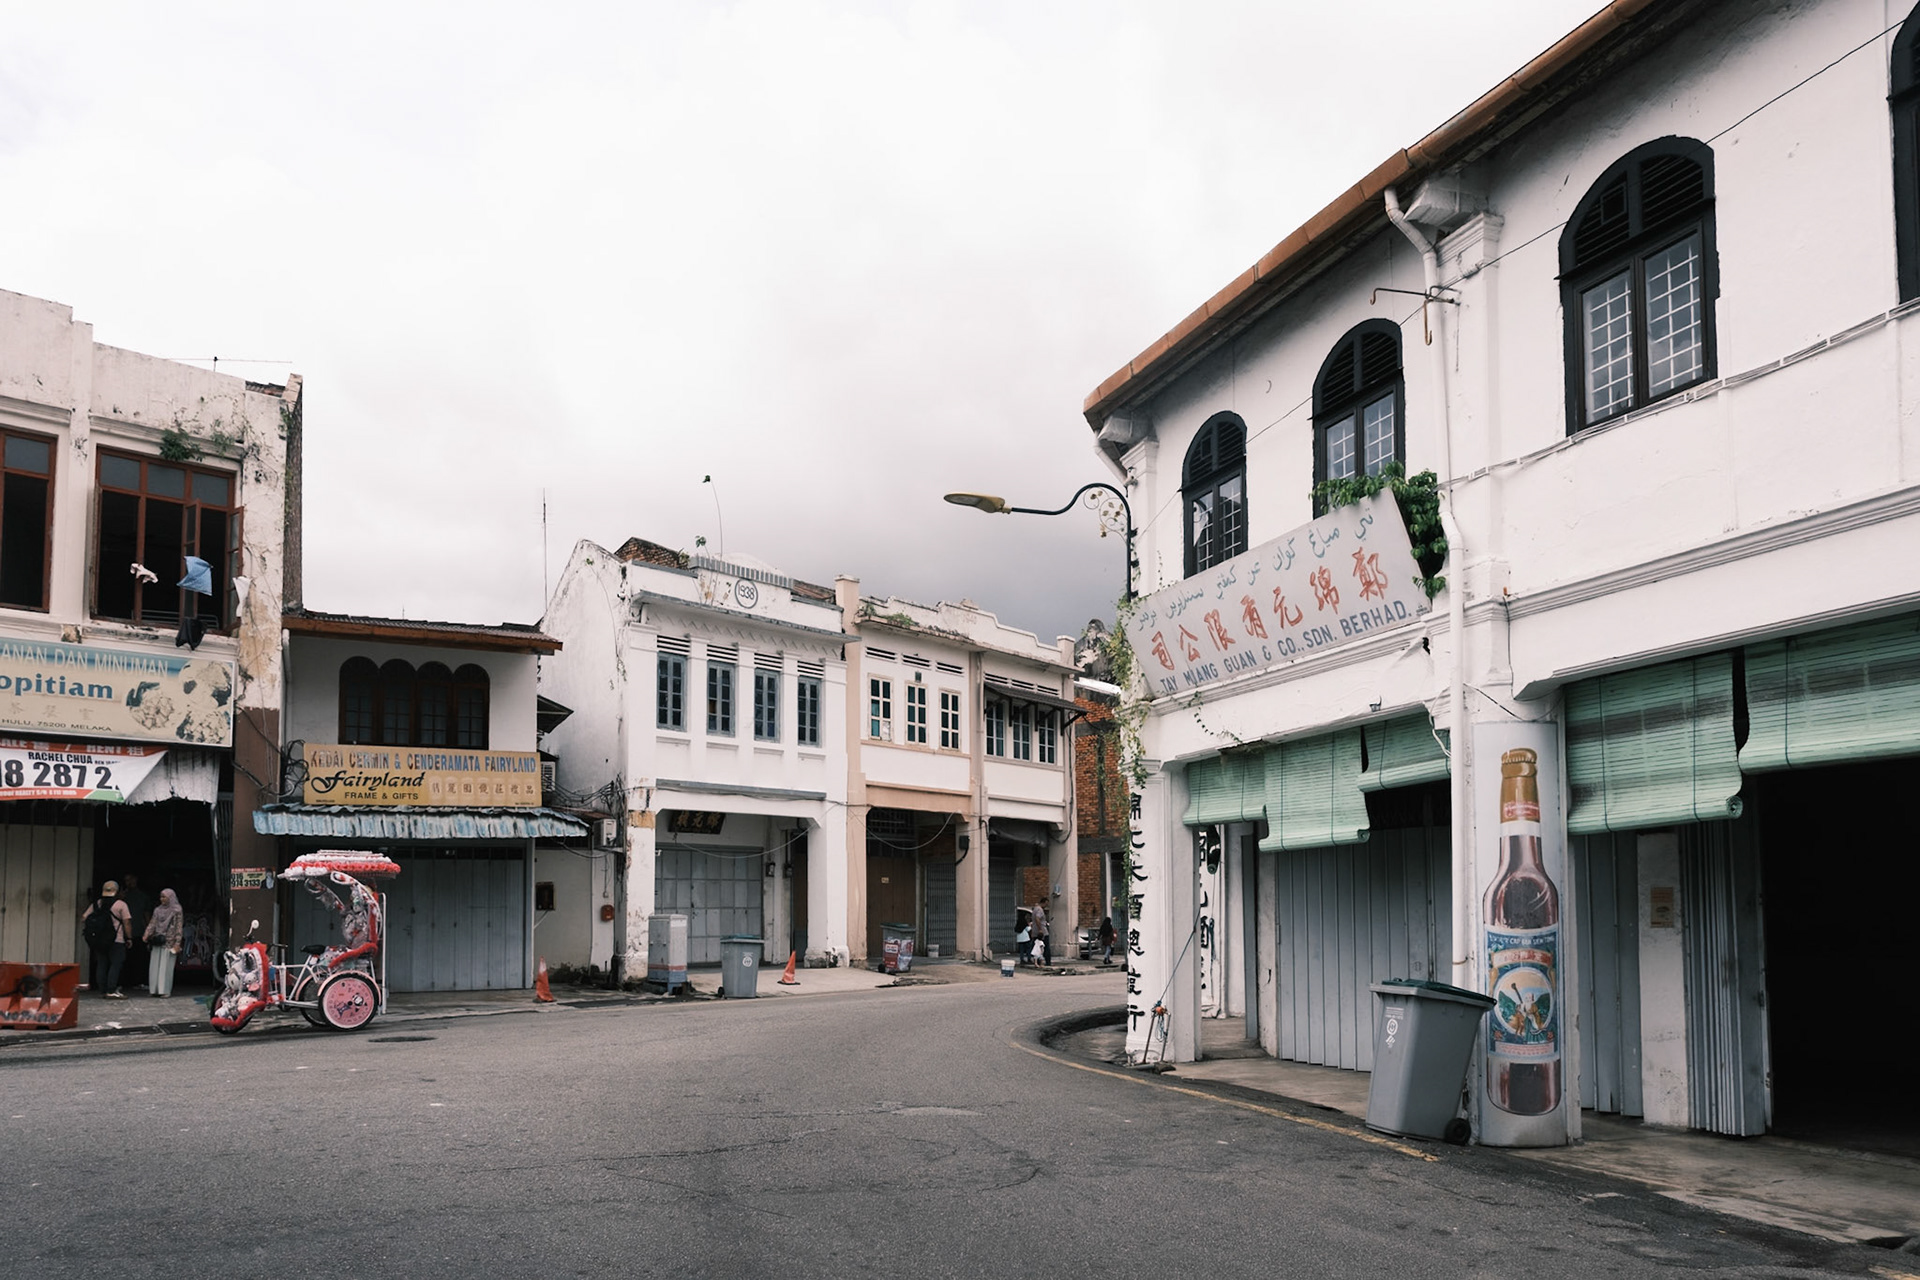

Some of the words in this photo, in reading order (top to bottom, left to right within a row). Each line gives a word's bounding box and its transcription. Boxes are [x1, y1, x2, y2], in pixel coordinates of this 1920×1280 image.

[1160, 675, 1179, 693] TAY
[1183, 662, 1219, 687] MIANG
[1223, 650, 1257, 673] GUAN
[1261, 645, 1272, 661] &
[1303, 624, 1338, 649] SDN.
[1339, 600, 1412, 637] BERHAD.
[54, 649, 88, 671] DAN
[94, 652, 169, 678] MINUMAN
[37, 720, 66, 729] 75200
[70, 723, 112, 732] MELAKA
[0, 738, 27, 748] ALE
[86, 744, 121, 754] RENT
[28, 751, 64, 762] RACHEL
[66, 753, 93, 765] CHUA
[310, 750, 344, 768] KEDAI
[349, 752, 389, 769] CERMIN
[394, 753, 401, 770] &
[407, 753, 480, 772] CENDERAMATA
[484, 756, 536, 773] FAIRYLAND
[33, 761, 87, 788] 287
[94, 766, 120, 790] 2
[311, 770, 426, 794] Fairyland
[344, 791, 377, 800] FRAME
[382, 792, 388, 800] &
[392, 792, 419, 800] GIFTS
